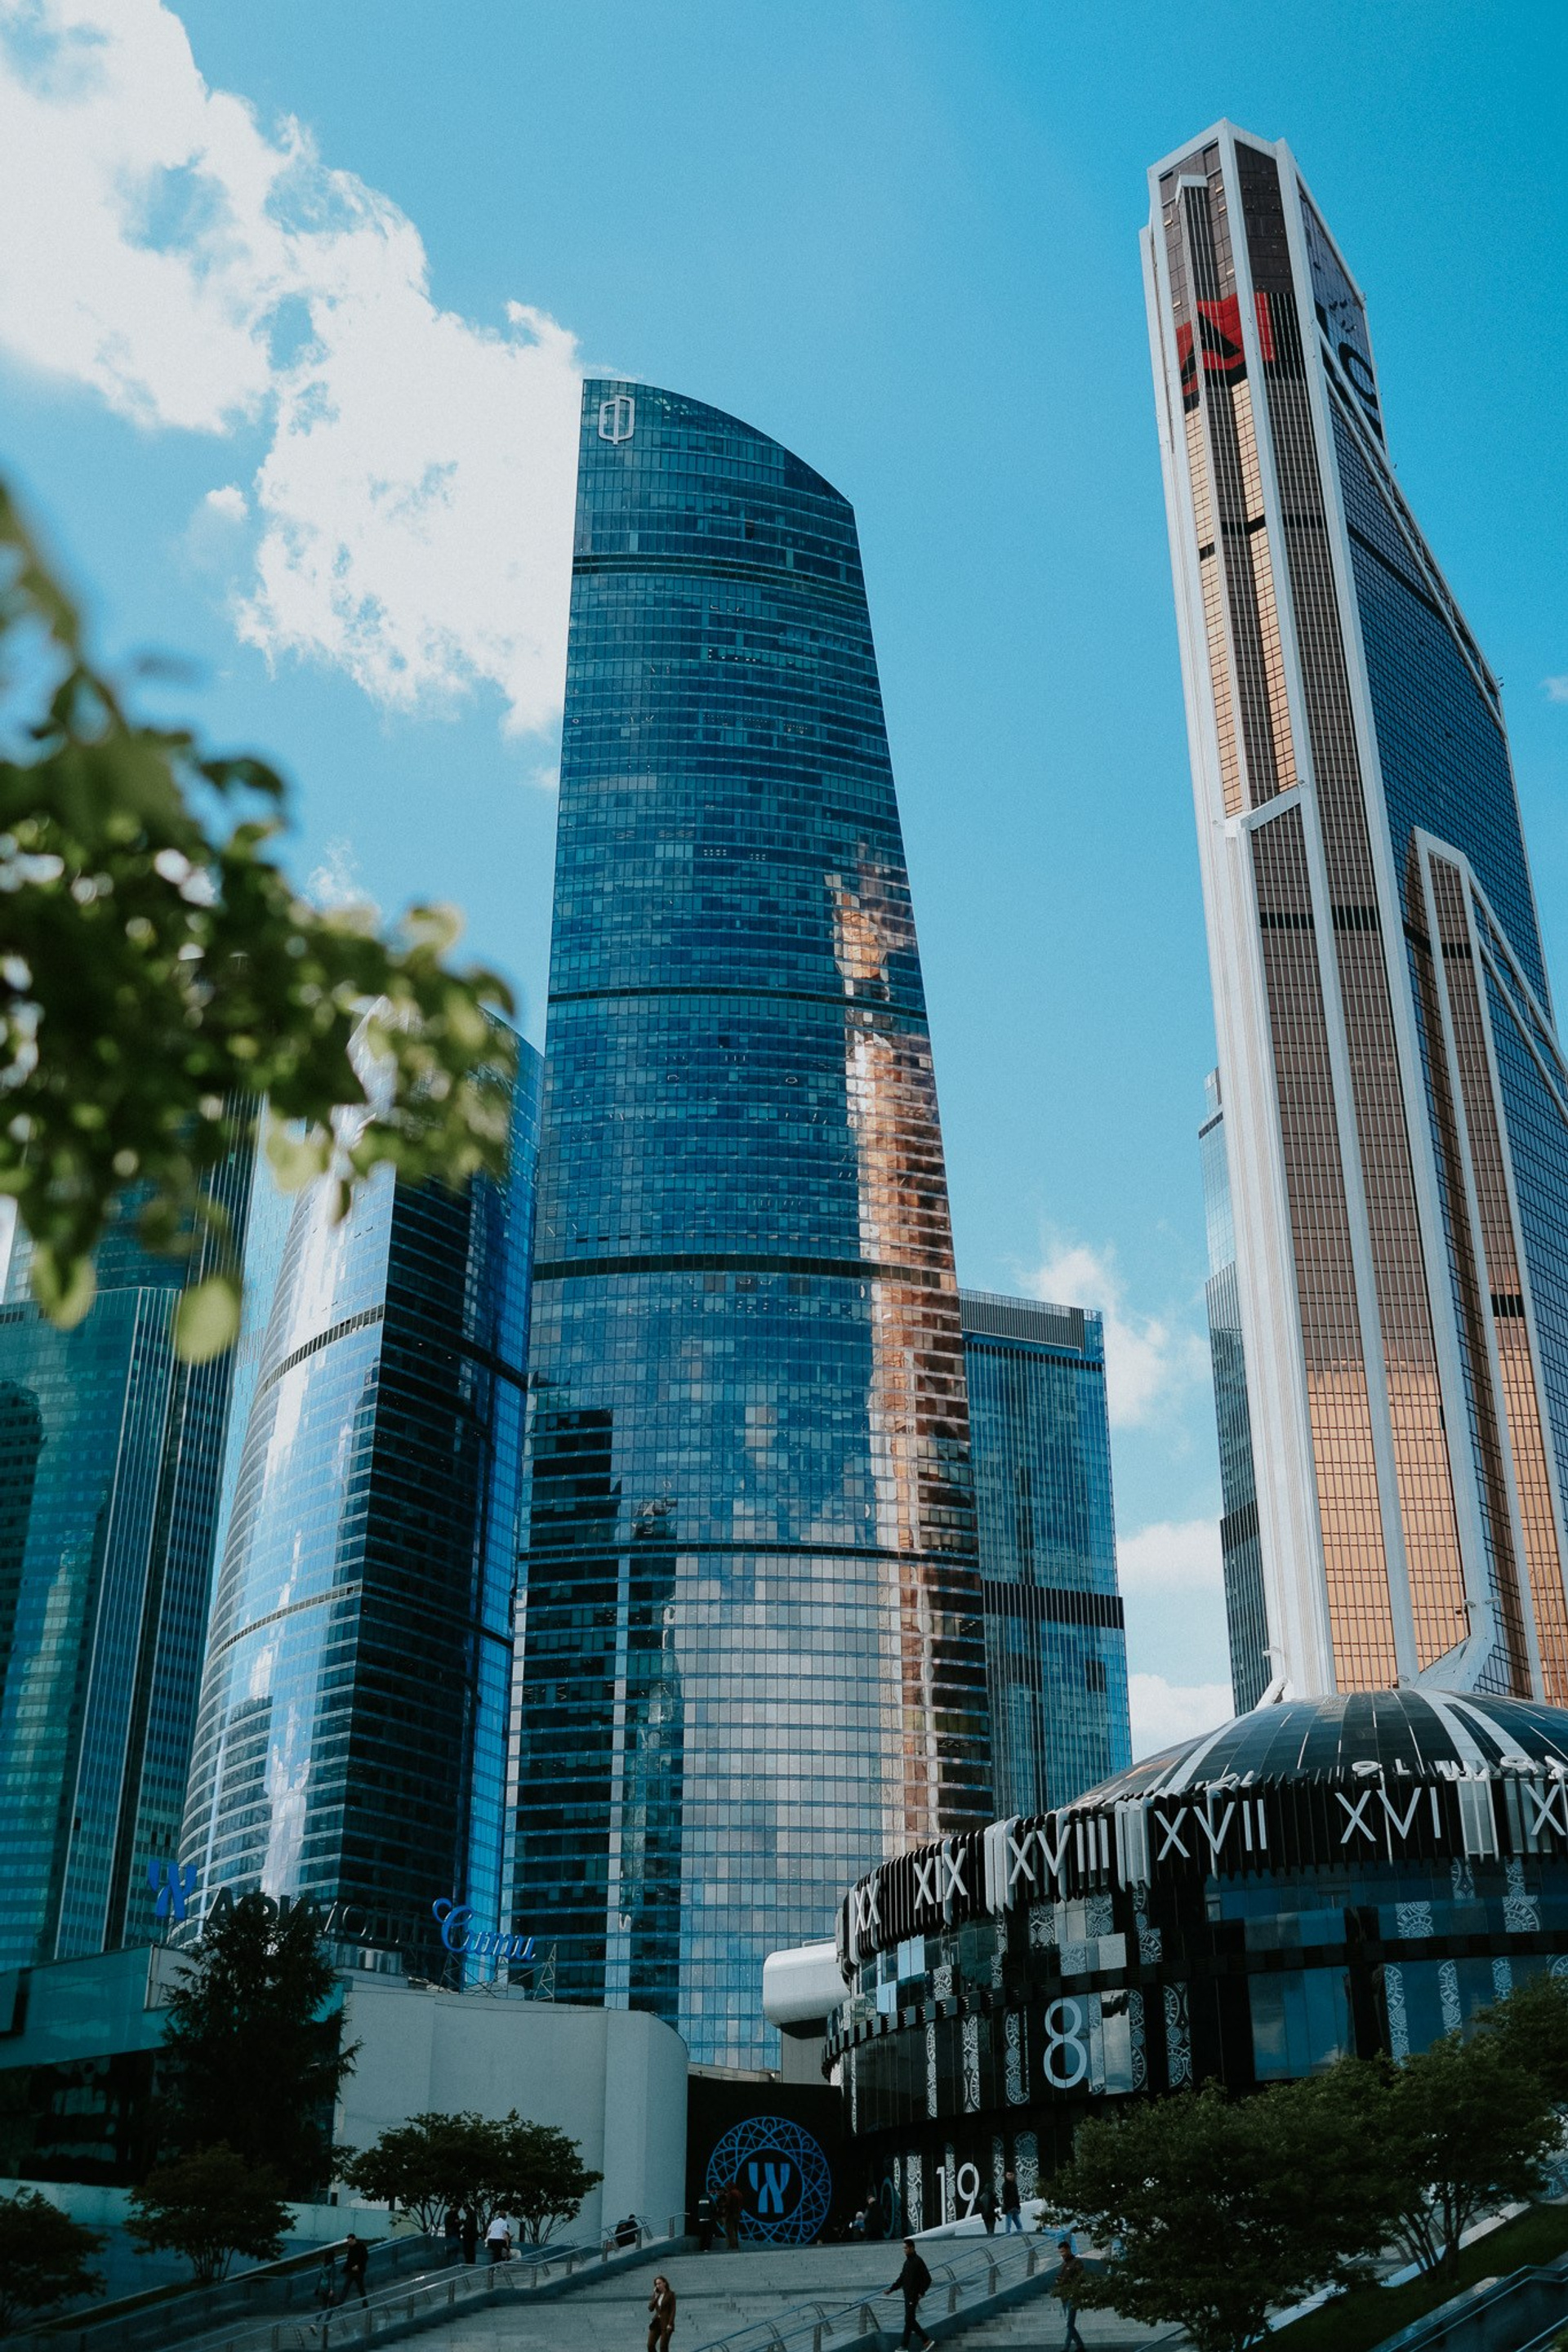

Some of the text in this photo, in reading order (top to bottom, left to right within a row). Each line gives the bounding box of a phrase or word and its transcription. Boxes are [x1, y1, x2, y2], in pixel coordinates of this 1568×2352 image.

[1154, 1799, 1267, 1861] XVII
[1335, 1787, 1441, 1844] XVI
[913, 1847, 969, 1909] XIX
[1007, 1818, 1109, 1886] XVIII
[854, 1878, 881, 1936] XX
[1044, 1997, 1087, 2088] 8
[936, 2162, 979, 2227] 19
